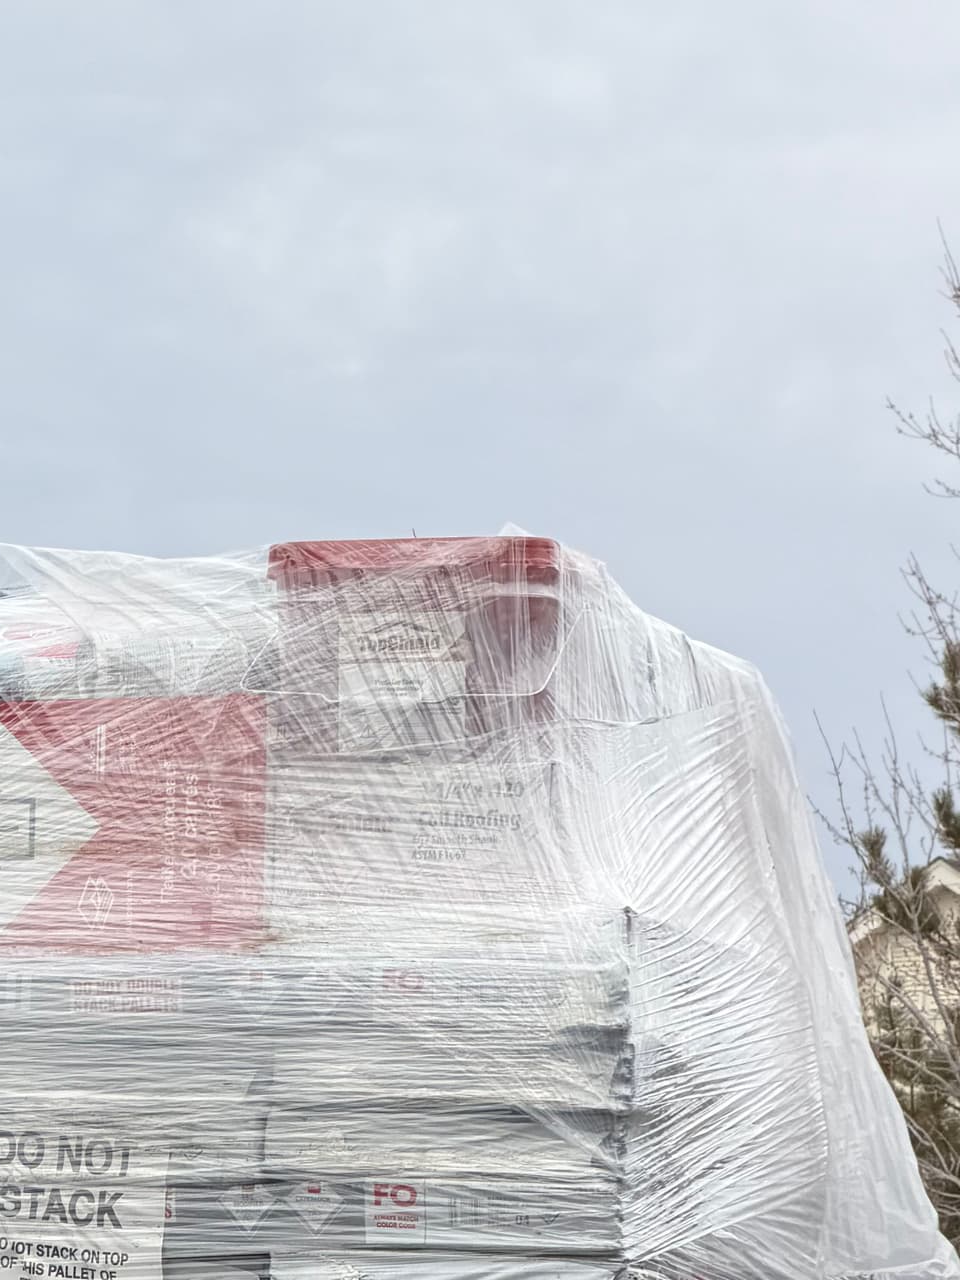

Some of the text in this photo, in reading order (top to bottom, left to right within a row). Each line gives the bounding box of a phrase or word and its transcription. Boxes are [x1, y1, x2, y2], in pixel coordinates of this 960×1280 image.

[383, 969, 423, 991] FO
[57, 1136, 131, 1178] NOT
[374, 1184, 417, 1207] FO
[36, 1243, 78, 1260] STACK
[81, 1251, 100, 1263] ON
[103, 1251, 129, 1267] TOP
[1, 1256, 17, 1269] OF
[48, 1264, 95, 1280] PALLET
